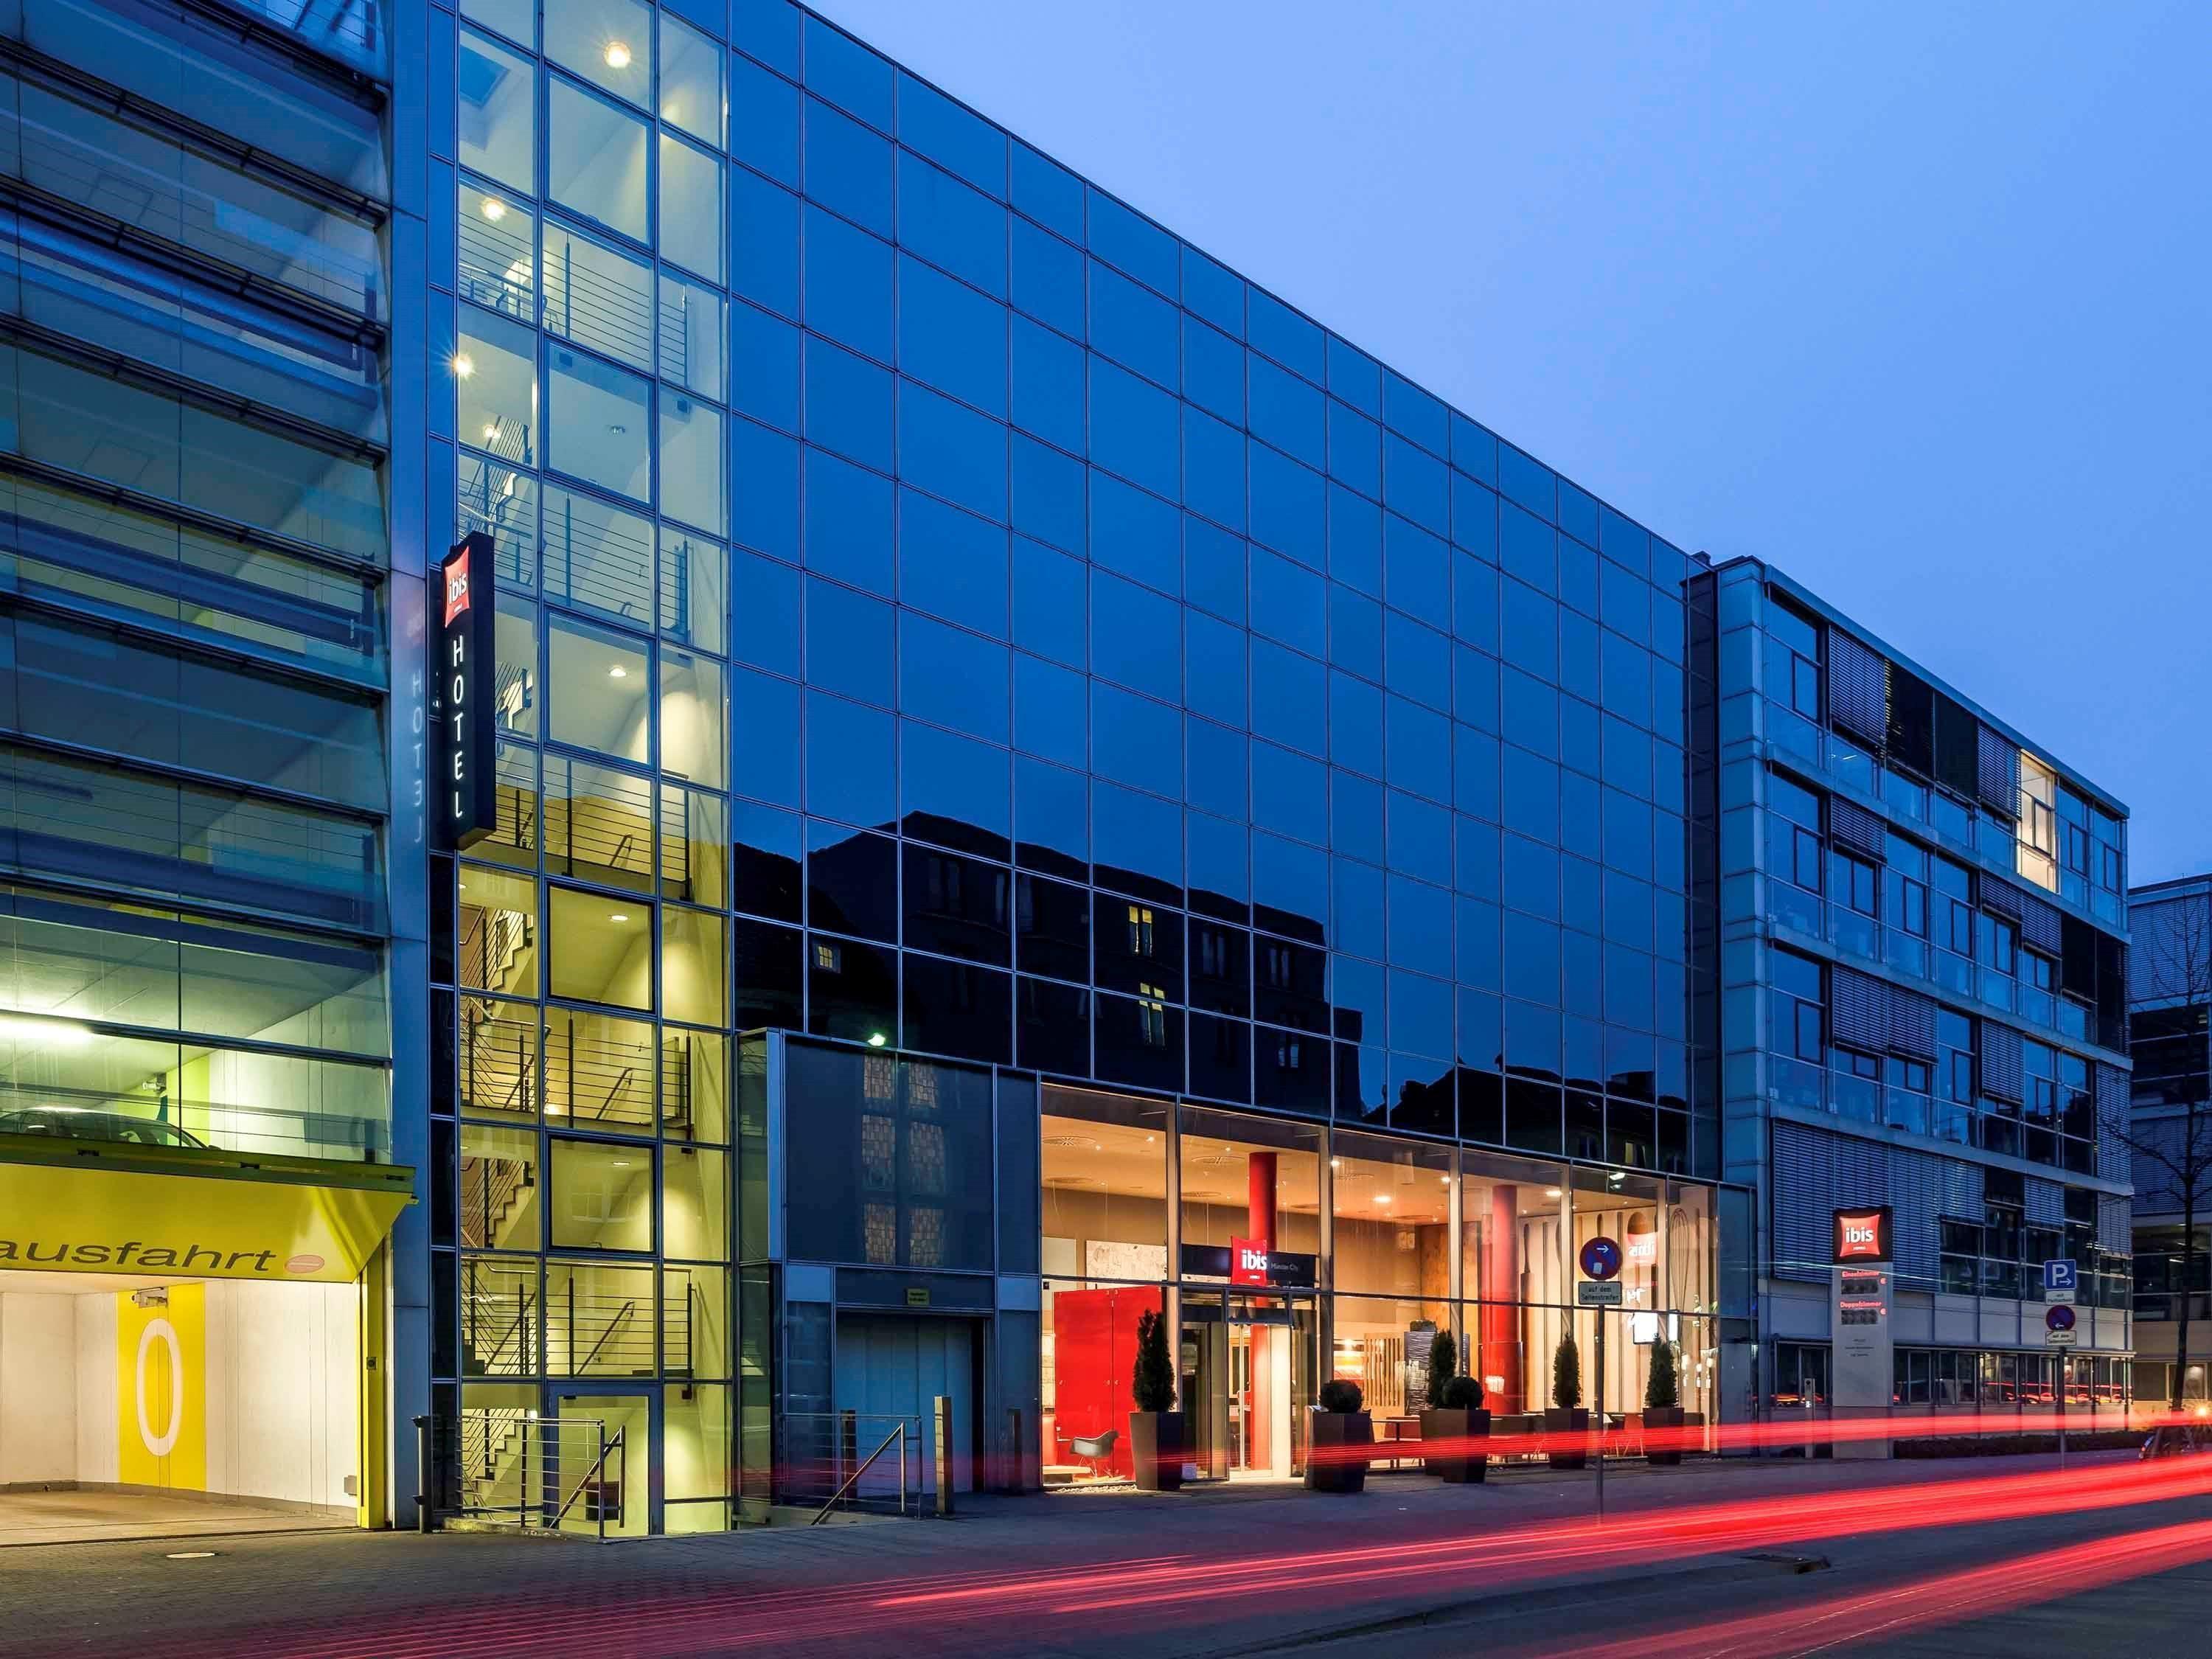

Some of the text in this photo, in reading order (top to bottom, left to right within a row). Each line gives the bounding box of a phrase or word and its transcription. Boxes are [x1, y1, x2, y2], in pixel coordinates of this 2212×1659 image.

[448, 572, 467, 605] ibis
[453, 635, 465, 819] HOTEL
[1846, 1226, 1874, 1244] ibis
[1241, 1248, 1267, 1271] ibis
[2052, 1264, 2068, 1286] P
